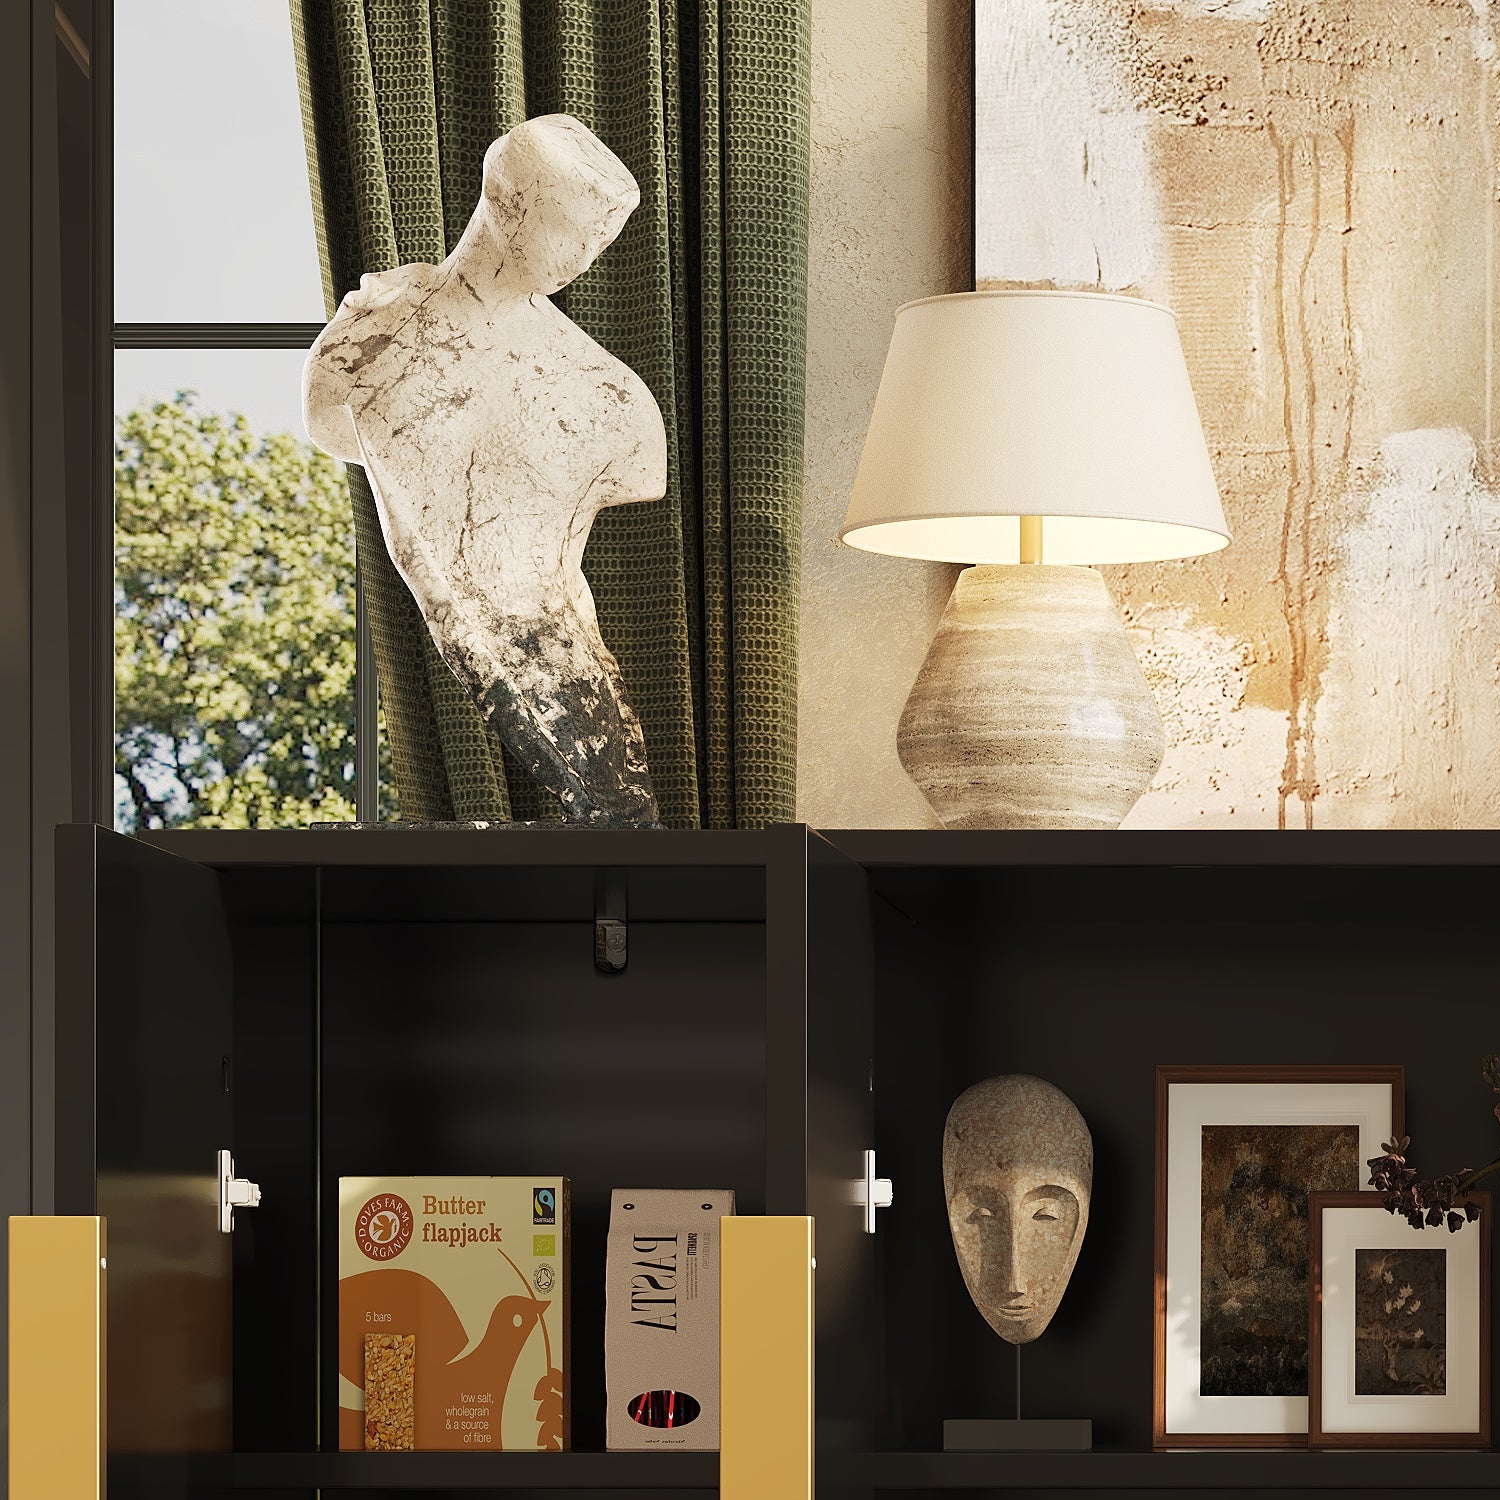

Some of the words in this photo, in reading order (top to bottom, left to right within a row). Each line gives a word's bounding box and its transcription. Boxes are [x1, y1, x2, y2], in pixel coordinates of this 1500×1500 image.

[422, 1195, 486, 1216] Butter
[358, 1199, 382, 1238] DOVES
[384, 1197, 410, 1223] FARM
[422, 1223, 502, 1247] flapjack
[364, 1228, 410, 1257] ORGANIC
[365, 1312, 372, 1322] 5
[373, 1311, 392, 1322] bars
[461, 1394, 474, 1403] low
[476, 1393, 494, 1405] salt,
[445, 1406, 489, 1419] wholegrain
[445, 1420, 451, 1430] &
[453, 1422, 458, 1430] a
[460, 1422, 489, 1430] source
[463, 1433, 473, 1443] of
[474, 1433, 491, 1443] fibre
